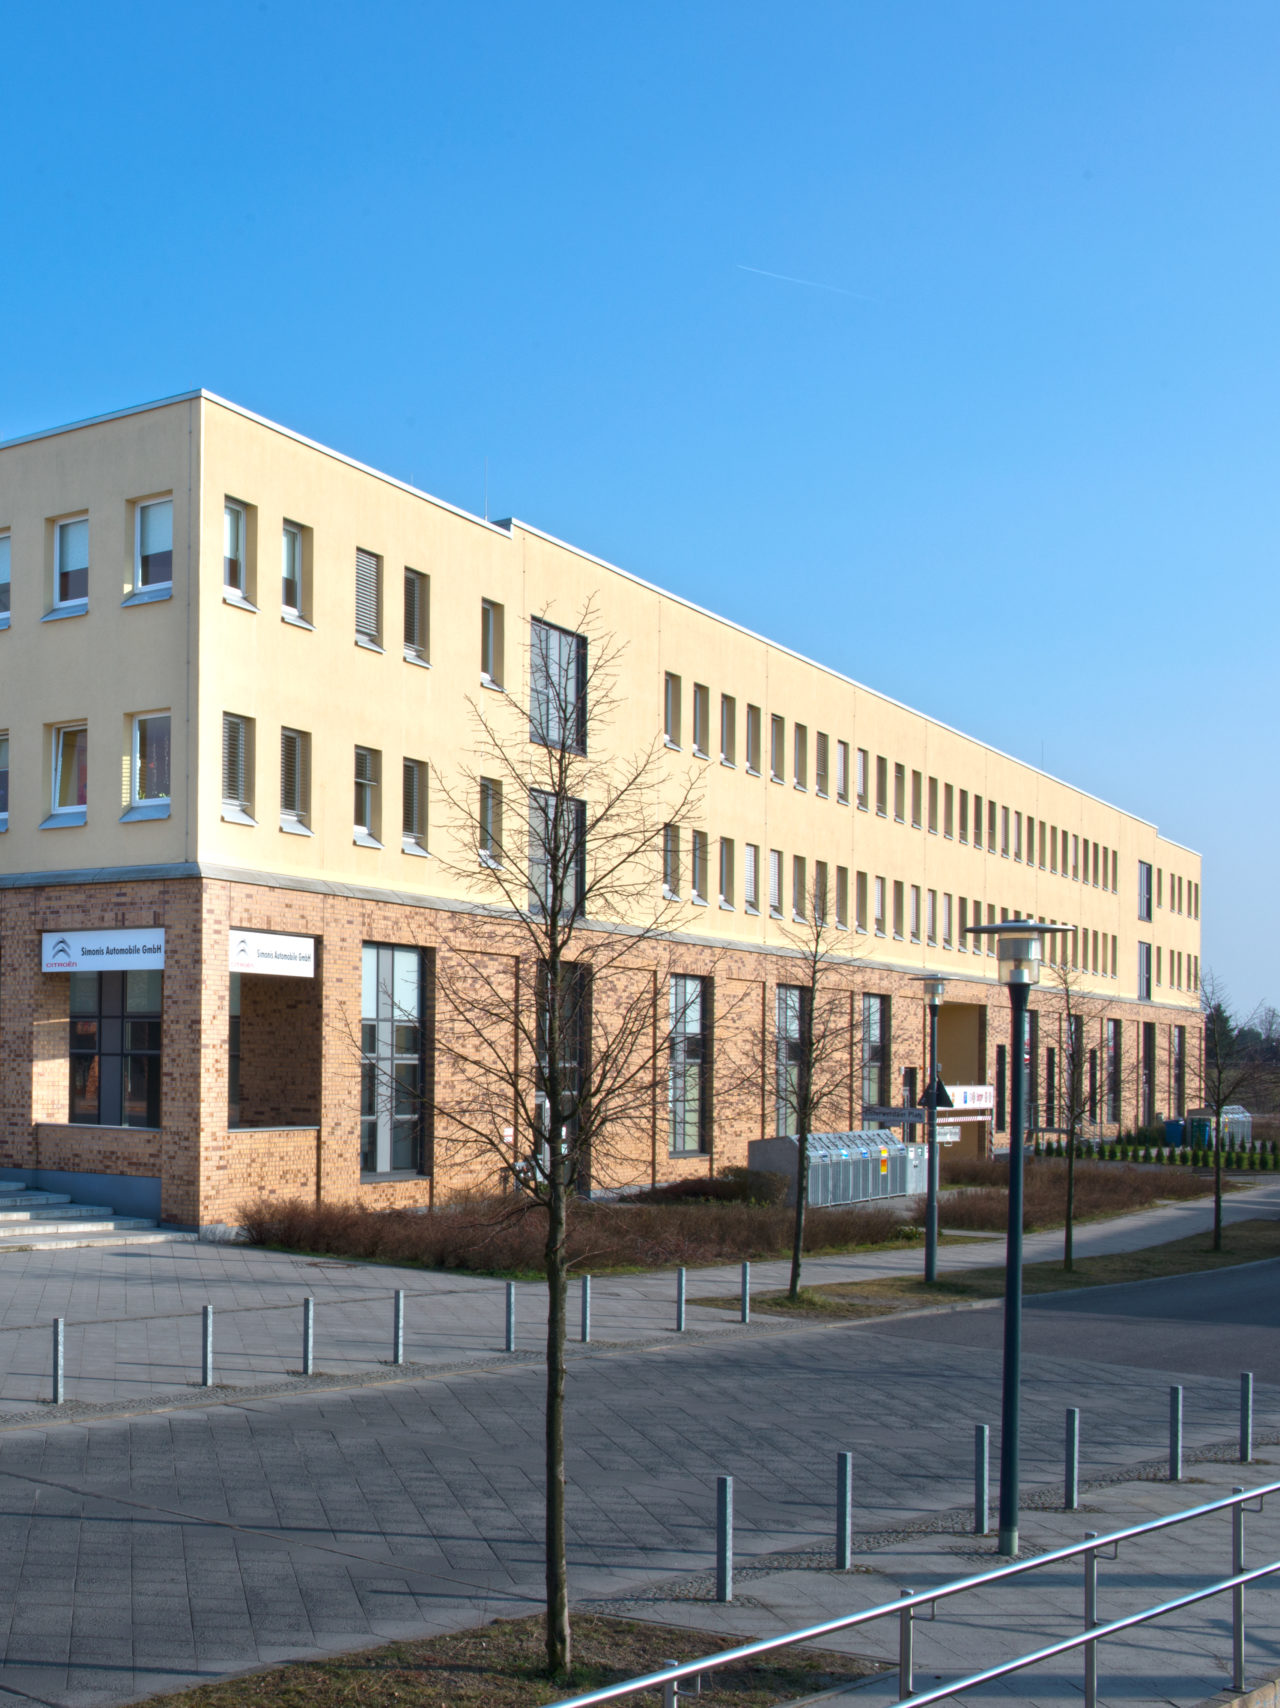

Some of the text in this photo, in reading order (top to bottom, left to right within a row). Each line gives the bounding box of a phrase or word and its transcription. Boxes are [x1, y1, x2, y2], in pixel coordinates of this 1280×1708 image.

[81, 943, 162, 956] Simonis Automobile GmbH
[274, 950, 298, 961] Automobile
[298, 952, 312, 962] GmbH
